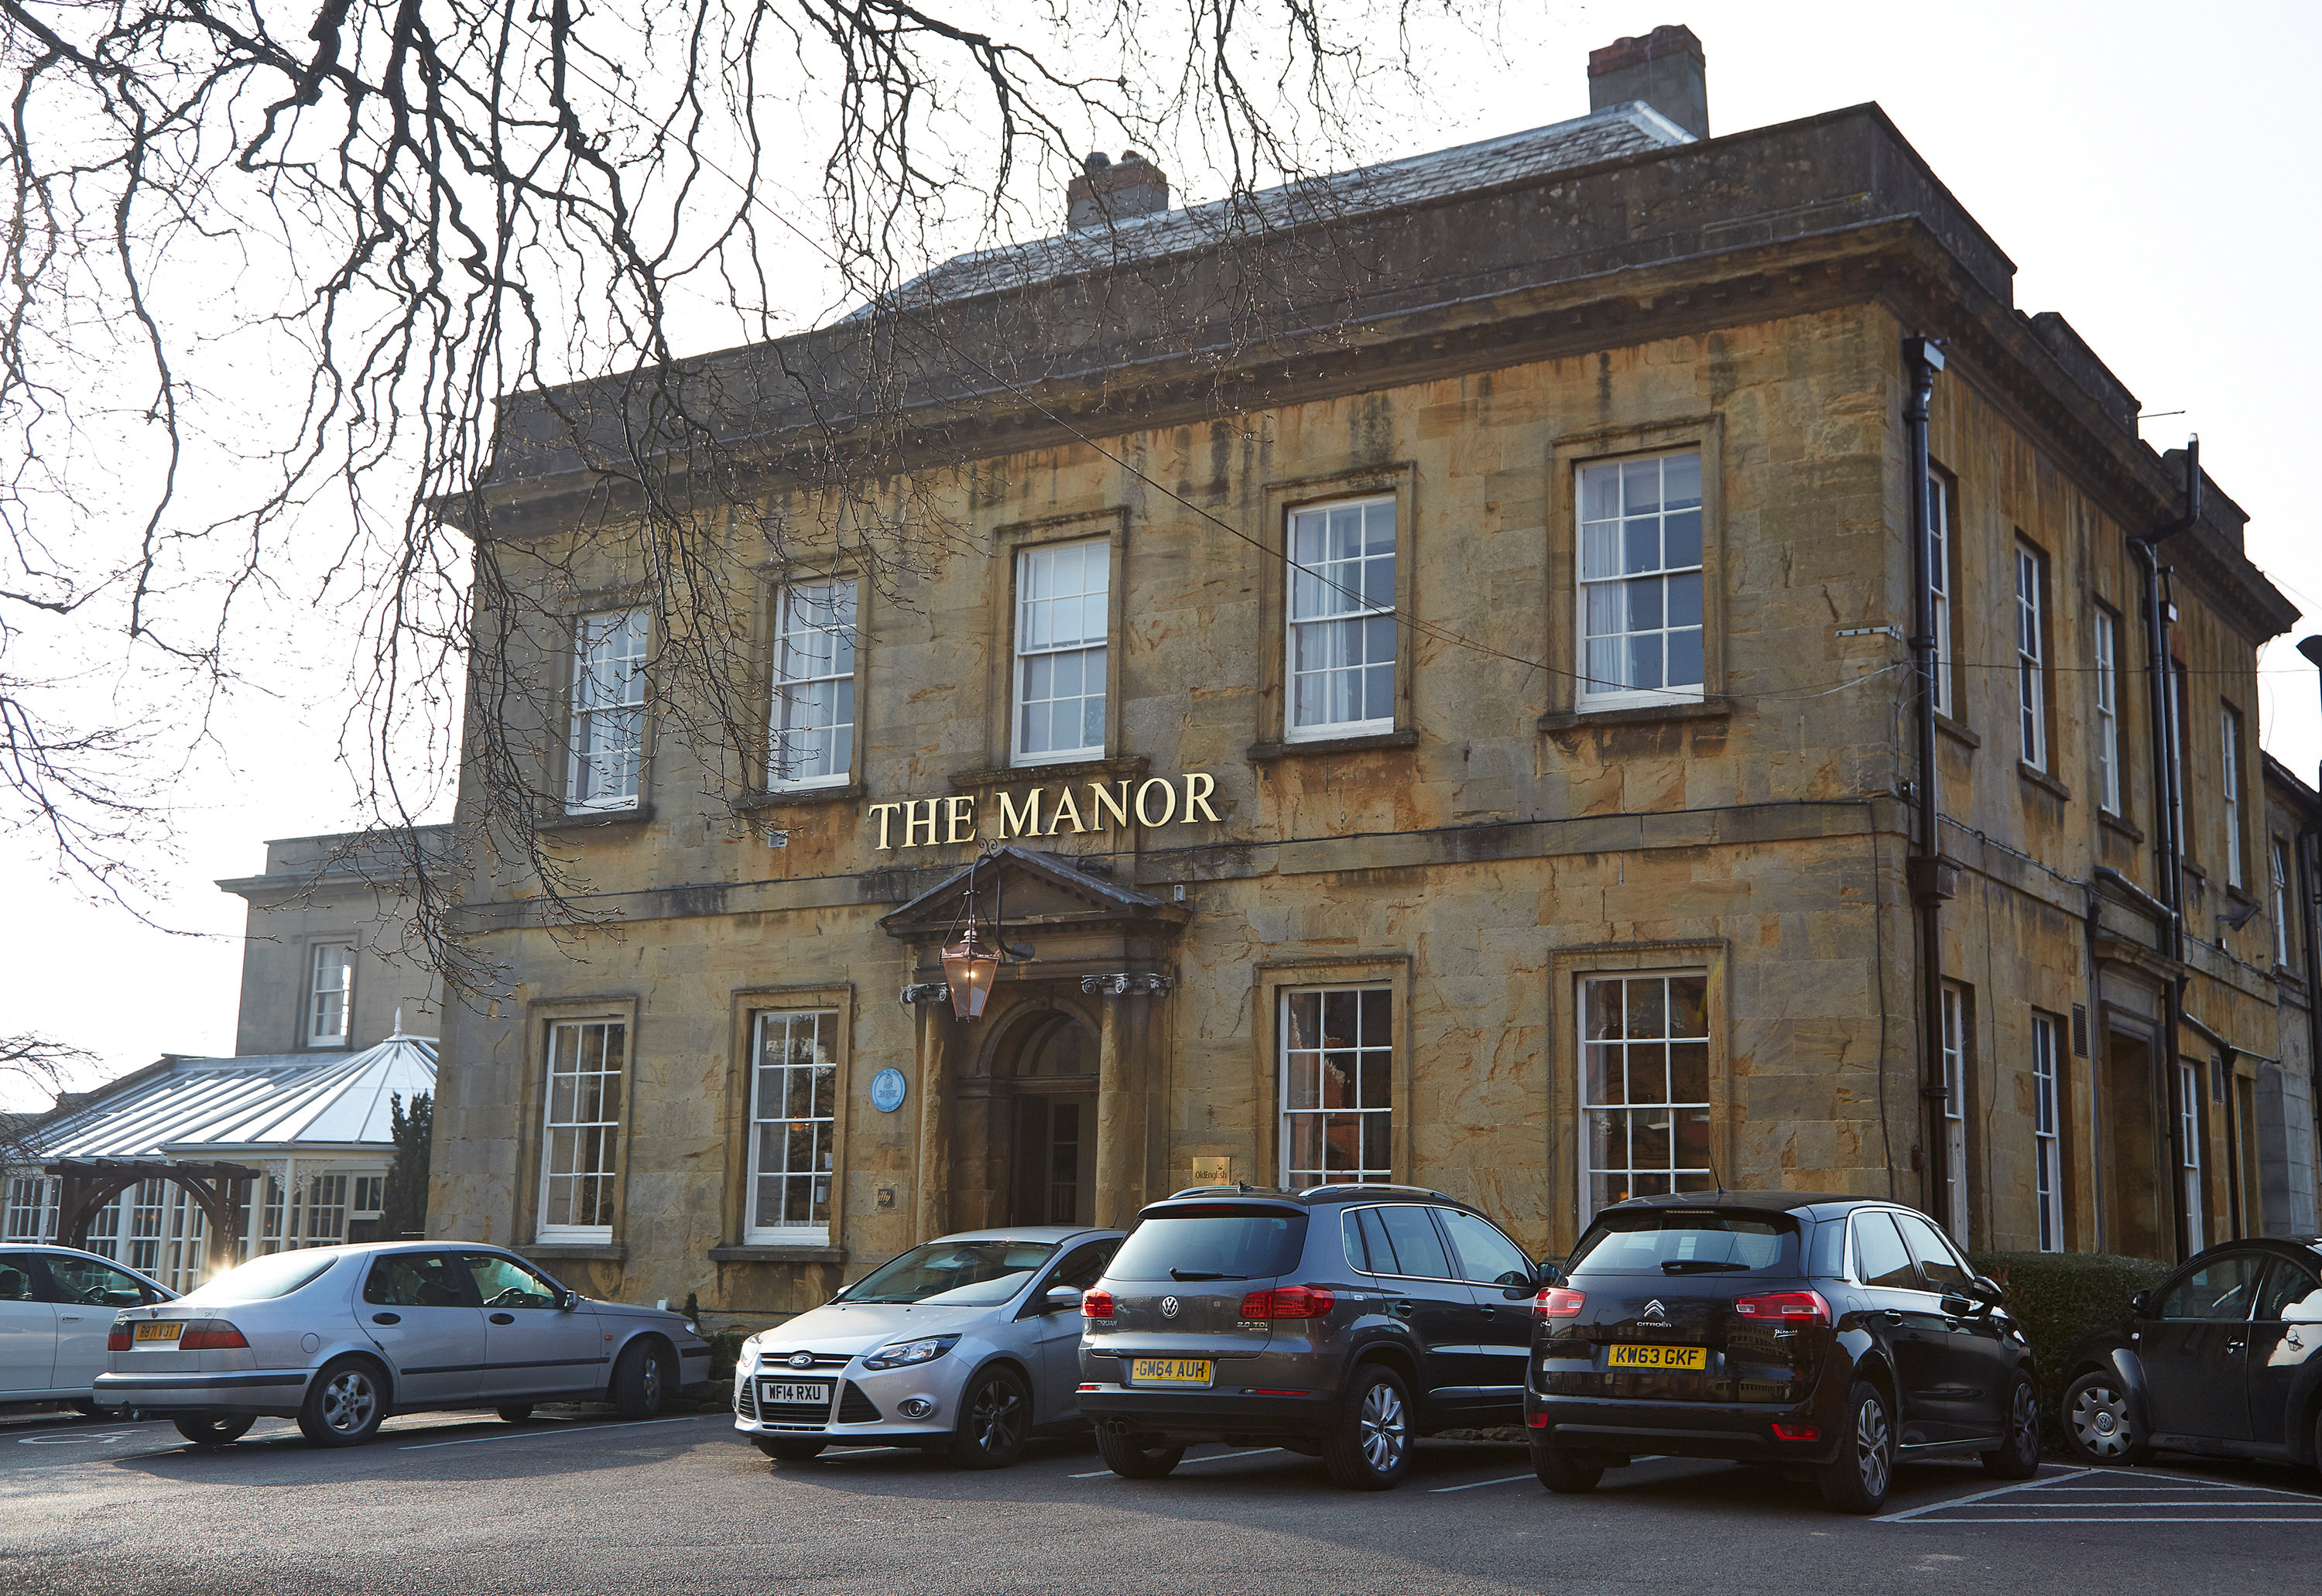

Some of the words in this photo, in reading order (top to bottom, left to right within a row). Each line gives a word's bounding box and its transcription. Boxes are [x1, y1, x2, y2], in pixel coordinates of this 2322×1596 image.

[869, 794, 977, 850] THE
[995, 772, 1223, 840] MANOR
[1195, 1170, 1227, 1180] OldEnglish
[878, 1190, 891, 1204] illy
[139, 1324, 158, 1338] R871
[1616, 1347, 1660, 1365] KW63
[1665, 1348, 1699, 1365] GKF
[1139, 1361, 1173, 1376] GM64
[1176, 1361, 1205, 1378] AUH
[769, 1385, 793, 1400] WF14
[797, 1385, 820, 1400] RXU
